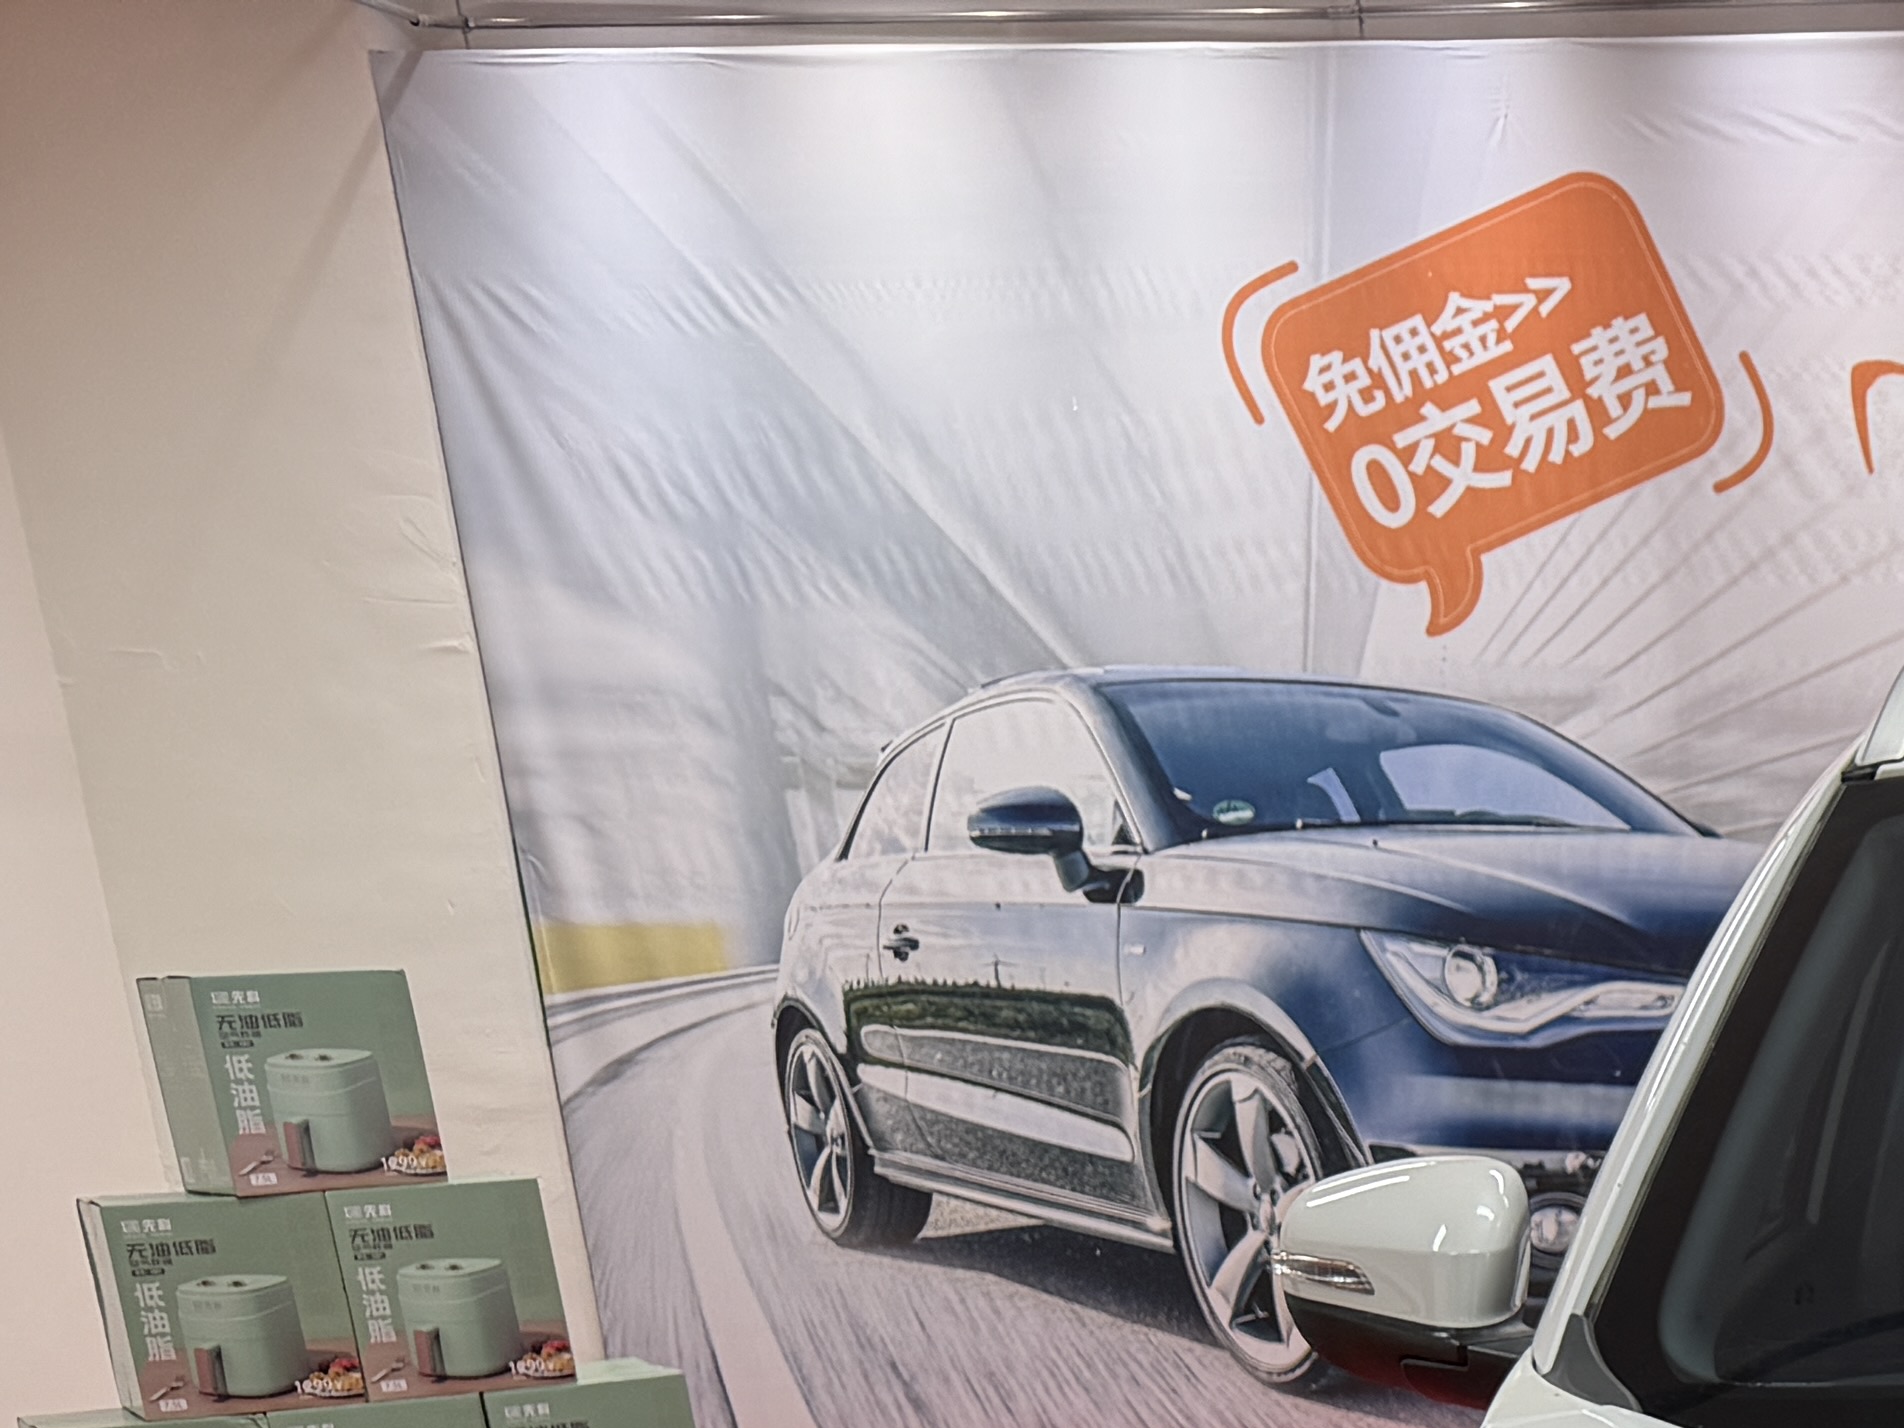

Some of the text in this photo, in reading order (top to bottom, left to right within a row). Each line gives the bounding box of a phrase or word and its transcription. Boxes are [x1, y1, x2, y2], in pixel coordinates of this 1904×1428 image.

[1350, 312, 1693, 530] 0交易费
[216, 1011, 304, 1032] 无油低脂
[224, 1054, 266, 1135] 低油脂
[126, 1238, 216, 1260] 无油低脂
[135, 1281, 177, 1361] 低油脂
[357, 1266, 397, 1344] 低油脂
